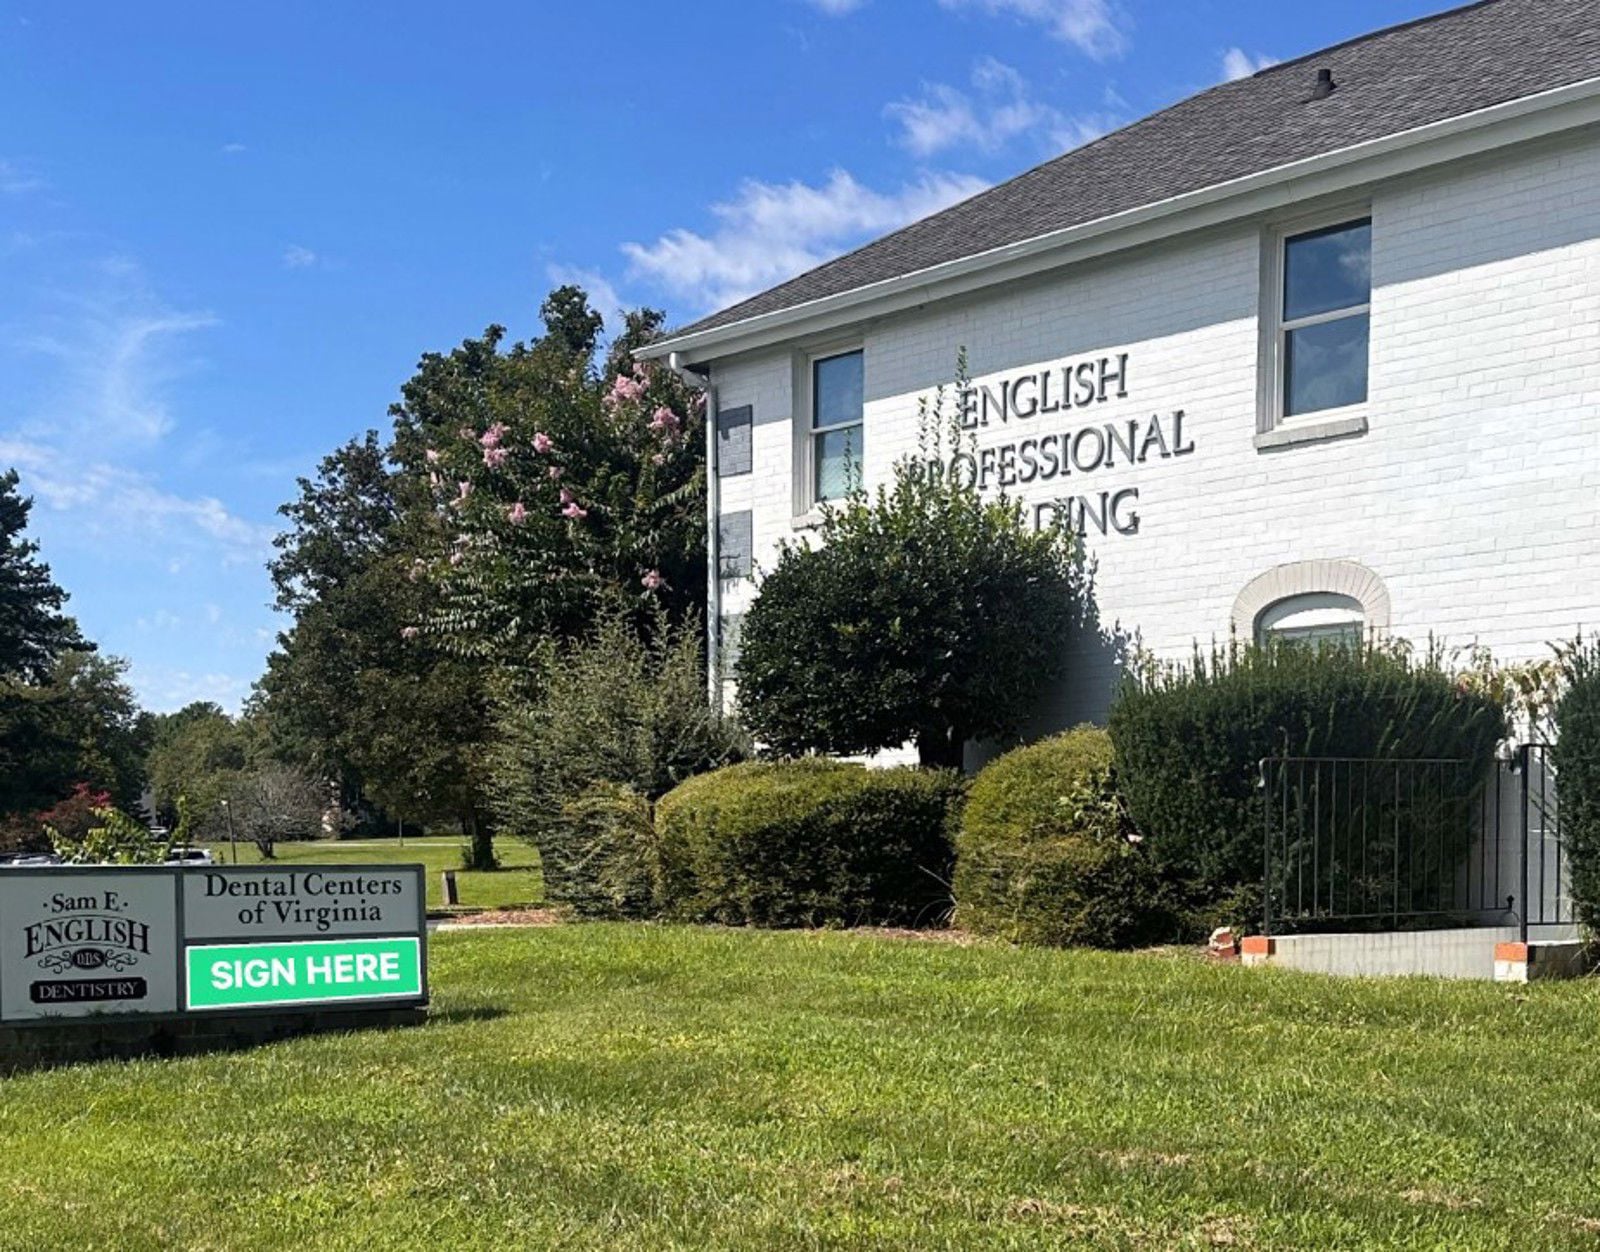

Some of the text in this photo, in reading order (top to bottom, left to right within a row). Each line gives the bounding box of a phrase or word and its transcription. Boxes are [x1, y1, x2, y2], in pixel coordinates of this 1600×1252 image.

[960, 353, 1129, 431] ENGLISH
[205, 873, 402, 897] Dental Centers
[52, 891, 98, 914] Sam
[238, 899, 382, 932] of Virginia
[24, 915, 151, 958] ENGLISH
[210, 953, 400, 989] SIGN HERE
[38, 982, 138, 999] DENTISTRY
